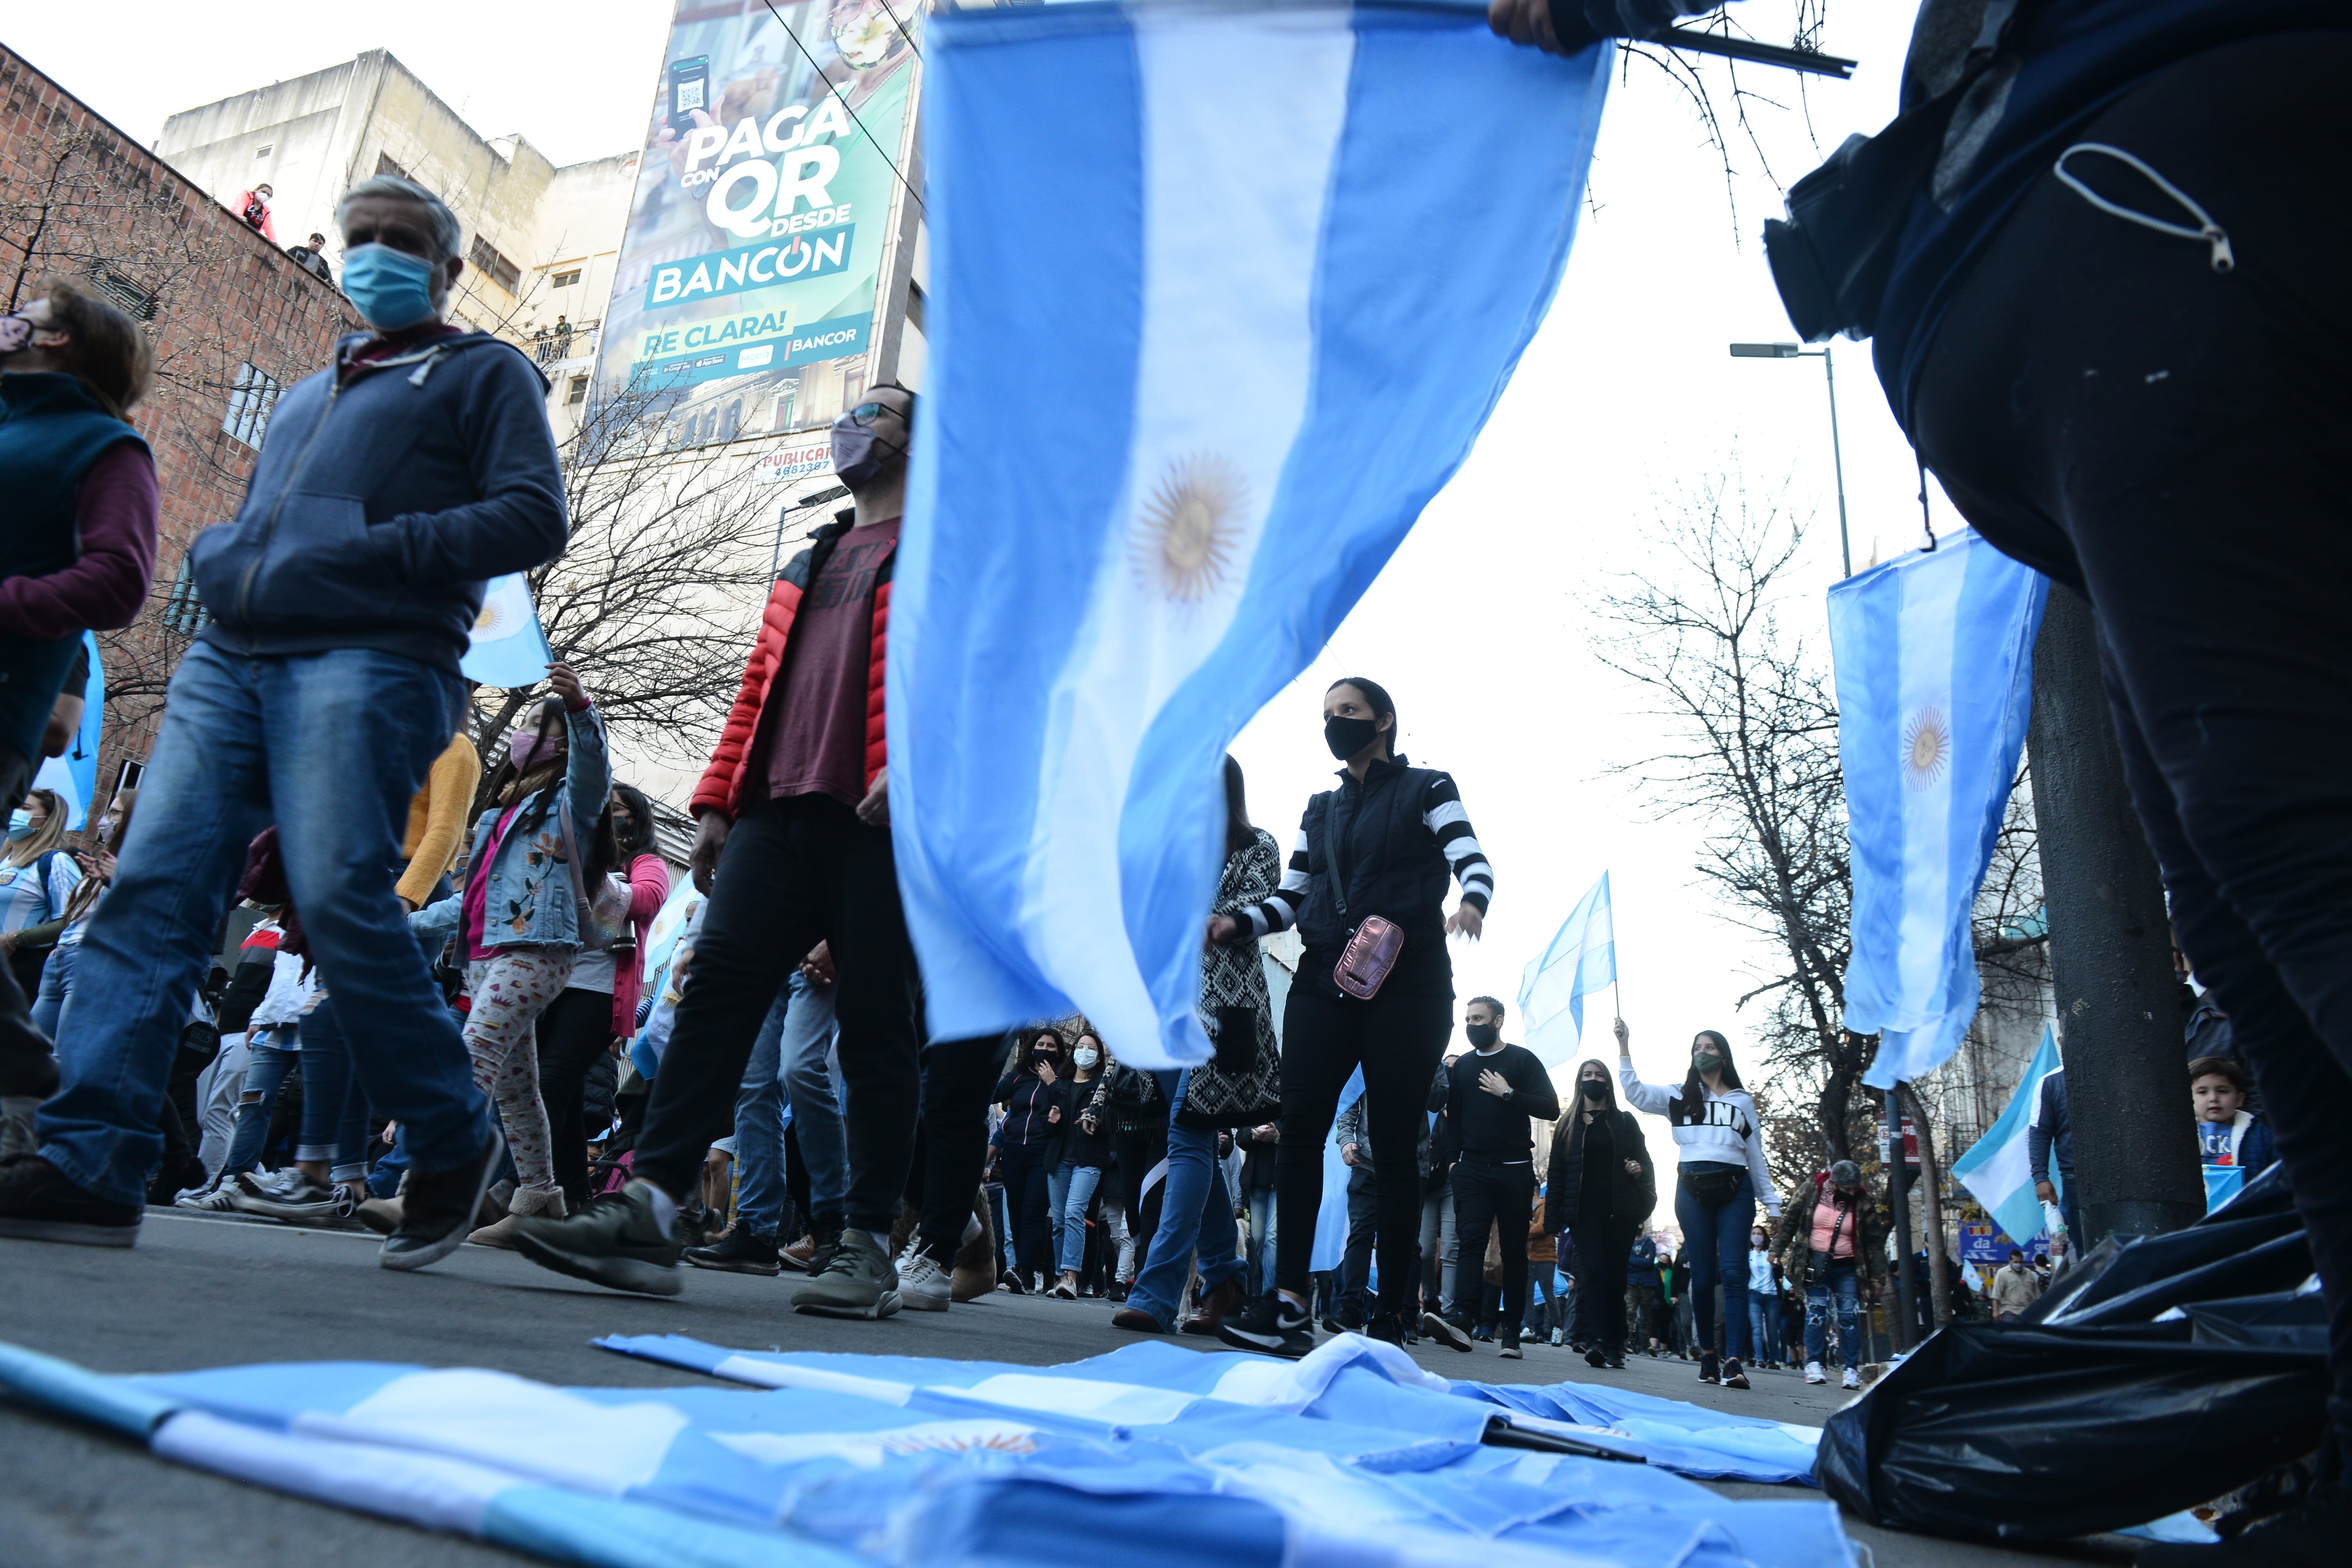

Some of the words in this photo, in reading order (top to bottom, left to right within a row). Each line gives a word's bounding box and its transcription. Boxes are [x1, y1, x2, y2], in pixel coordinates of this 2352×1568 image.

[684, 81, 850, 173] PAGÁ
[681, 167, 720, 188] CON
[706, 145, 840, 238] QR
[770, 203, 851, 237] DESDE
[644, 331, 679, 356] RE
[684, 310, 787, 348] CLARA!
[792, 329, 857, 352] BANCOR
[742, 351, 769, 362] MODO
[1973, 1238, 1990, 1249] da
